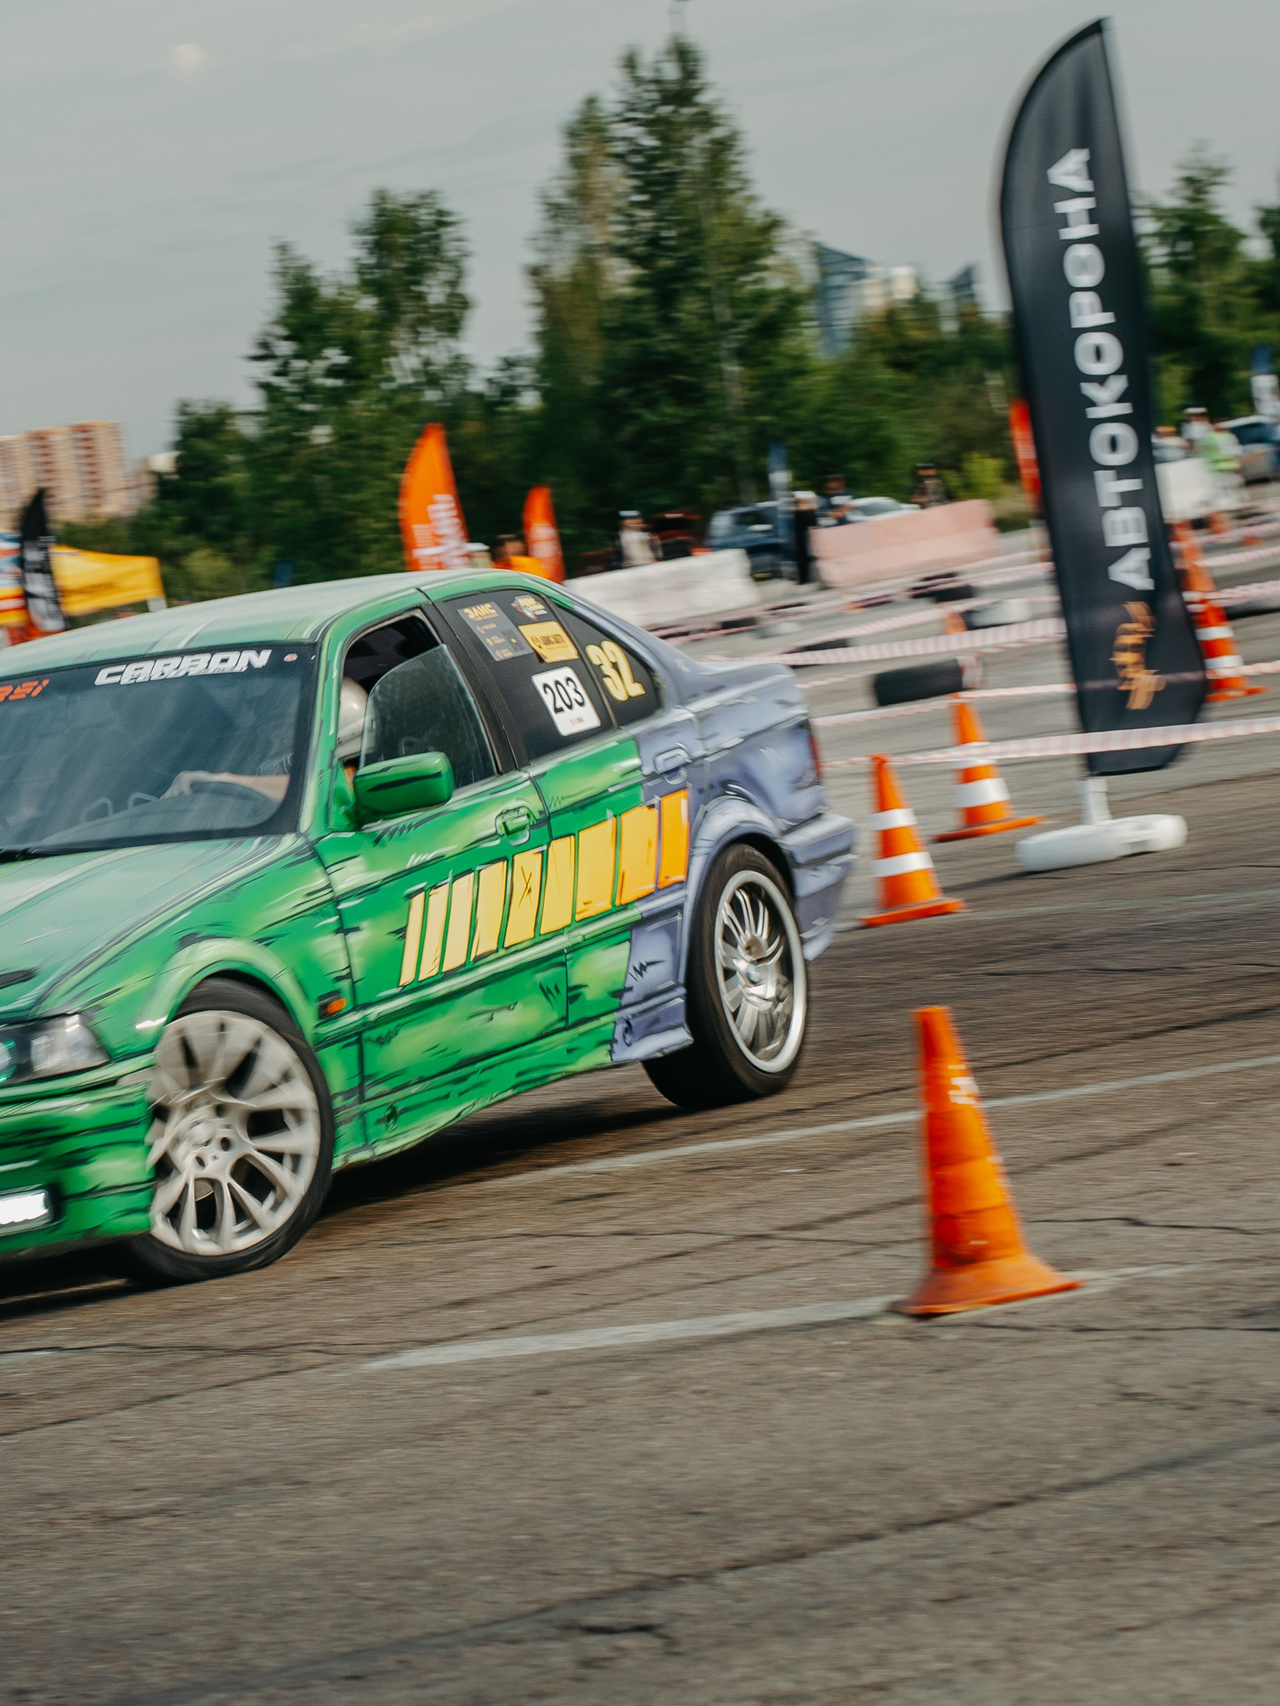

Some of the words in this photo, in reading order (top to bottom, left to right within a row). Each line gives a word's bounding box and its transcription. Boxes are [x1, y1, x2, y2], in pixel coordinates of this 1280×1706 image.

[1046, 147, 1156, 591] АВТОКОРОНА
[94, 649, 273, 686] CARBON
[585, 640, 646, 701] 32
[542, 677, 585, 713] 203
